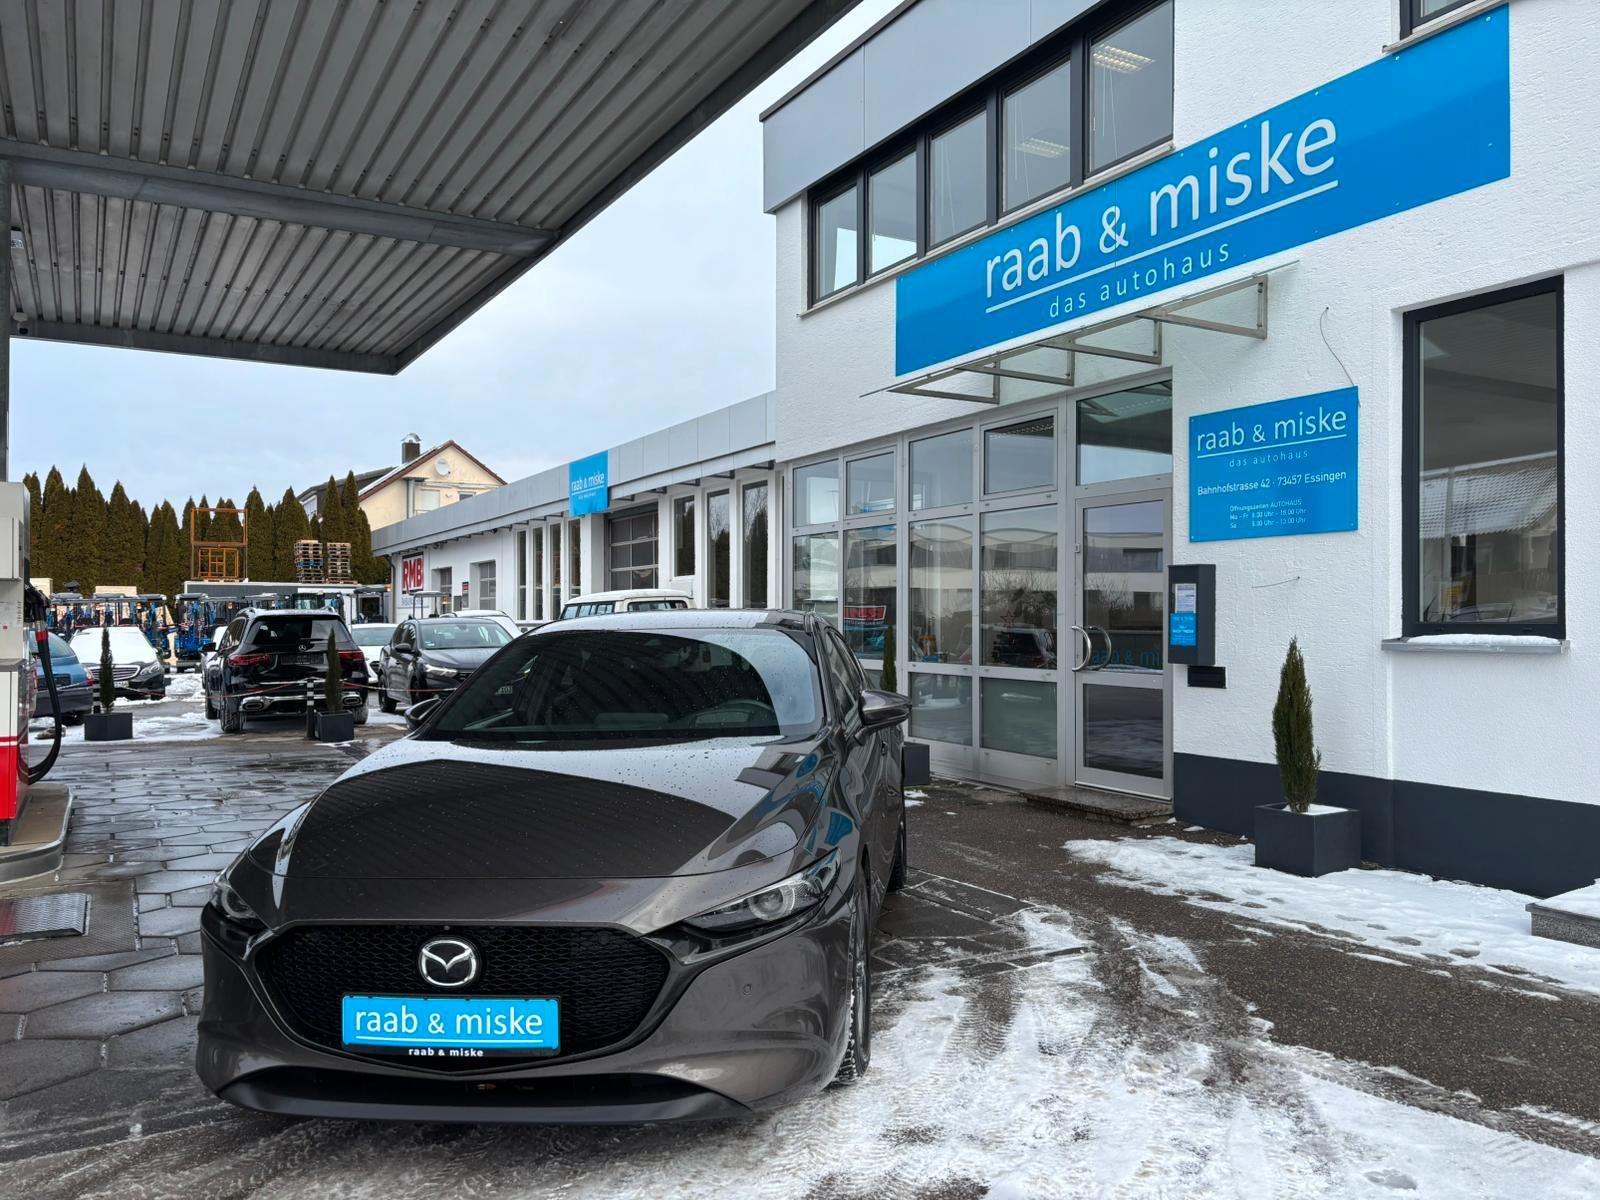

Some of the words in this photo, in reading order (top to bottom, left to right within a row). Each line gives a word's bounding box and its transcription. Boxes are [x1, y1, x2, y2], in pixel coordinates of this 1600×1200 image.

[986, 212, 1082, 298] raab
[1099, 205, 1129, 254] &
[1150, 116, 1337, 236] miske
[1049, 291, 1086, 318] das
[1100, 242, 1230, 301] autohaus
[1197, 421, 1245, 451] raab
[1252, 424, 1266, 443] &
[1274, 406, 1347, 439] miske
[1229, 458, 1247, 467] das
[1253, 451, 1308, 464] autohaus
[1197, 480, 1259, 496] Bahnhofstrasse
[1260, 478, 1271, 488] 42
[1278, 474, 1302, 487] 73457
[1304, 471, 1347, 484] Essingen
[1270, 499, 1302, 508] AUTOHAUS
[402, 557, 422, 591] RMB
[355, 1004, 418, 1034] raab
[427, 1012, 445, 1035] &
[456, 1006, 543, 1035] miske
[408, 1047, 435, 1056] raab
[449, 1048, 484, 1057] miske
